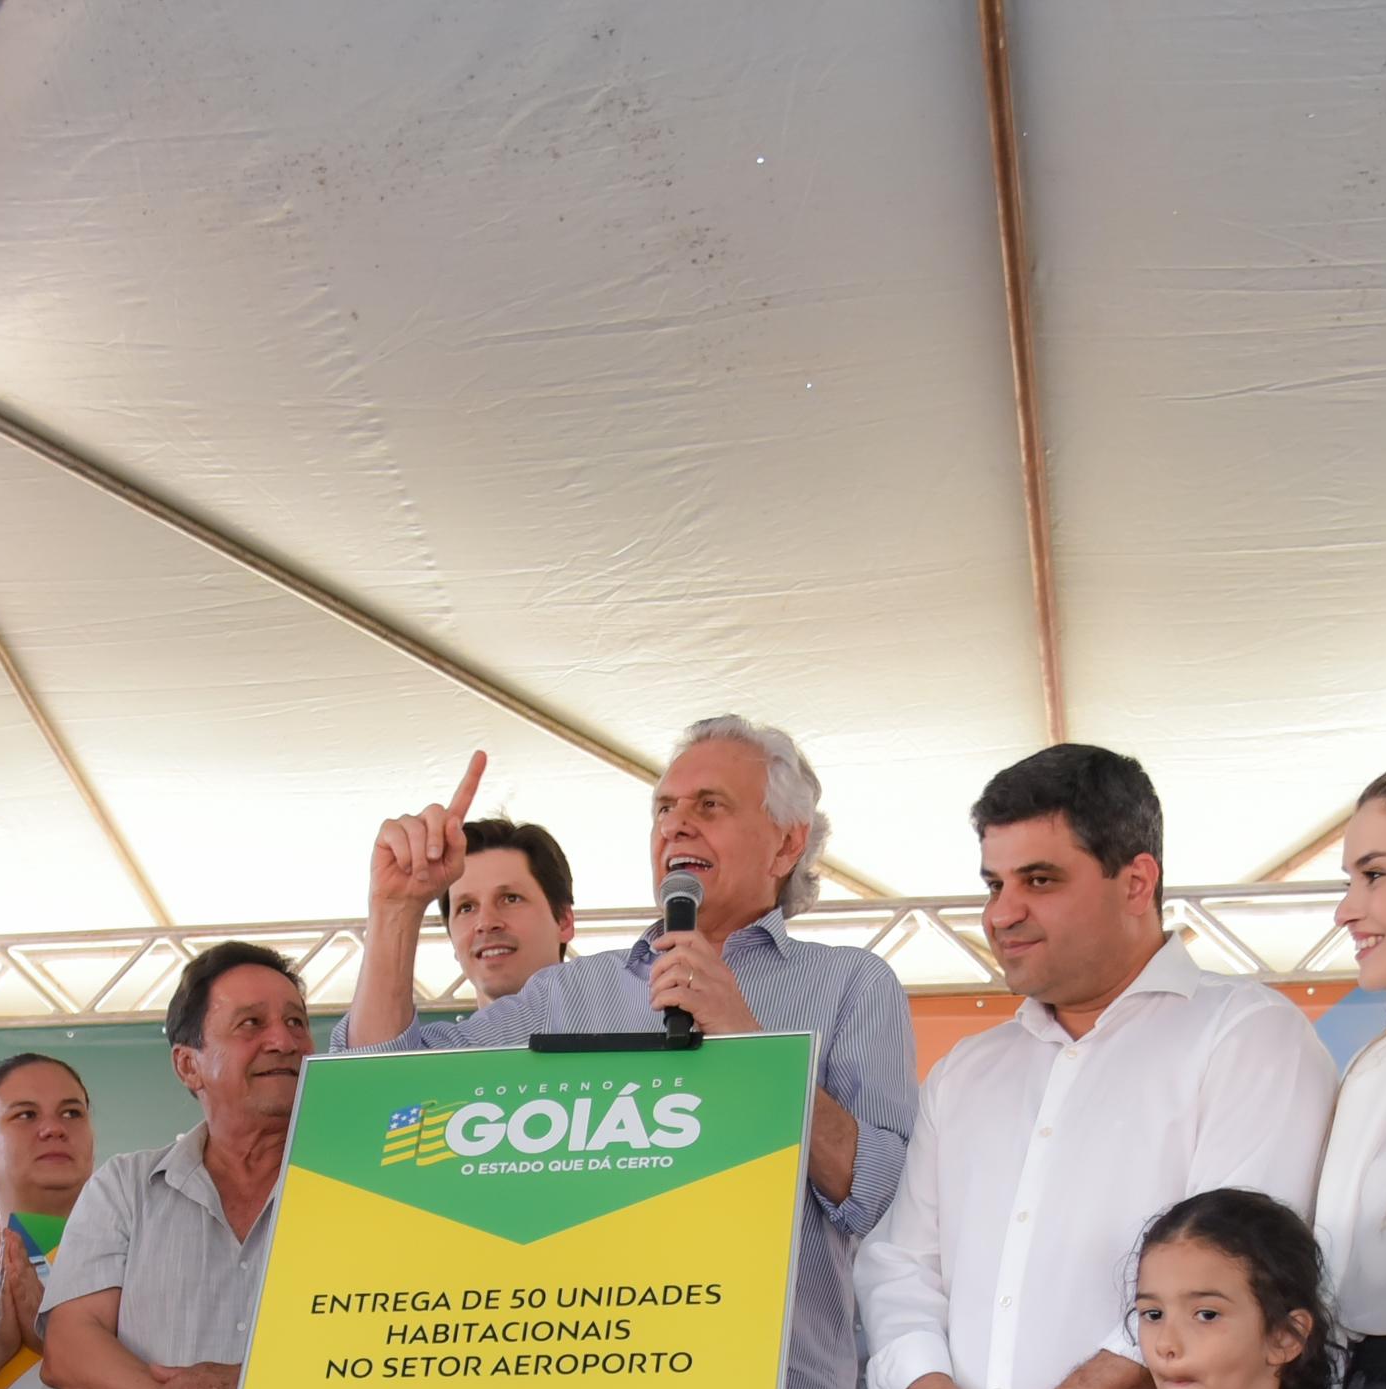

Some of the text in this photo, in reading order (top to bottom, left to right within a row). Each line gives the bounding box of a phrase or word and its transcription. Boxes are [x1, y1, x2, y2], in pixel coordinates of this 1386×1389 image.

[474, 1077, 683, 1096] GOVERNO DE
[444, 1082, 702, 1157] GOIÁS
[461, 1155, 673, 1175] O ESTADO QUE DÁ CERTO
[311, 1284, 721, 1314] ENTREGA DE 50 UNIDADES
[387, 1319, 630, 1344] HABITACIONAIS
[326, 1352, 692, 1379] NO SETOR AEROPORTO
